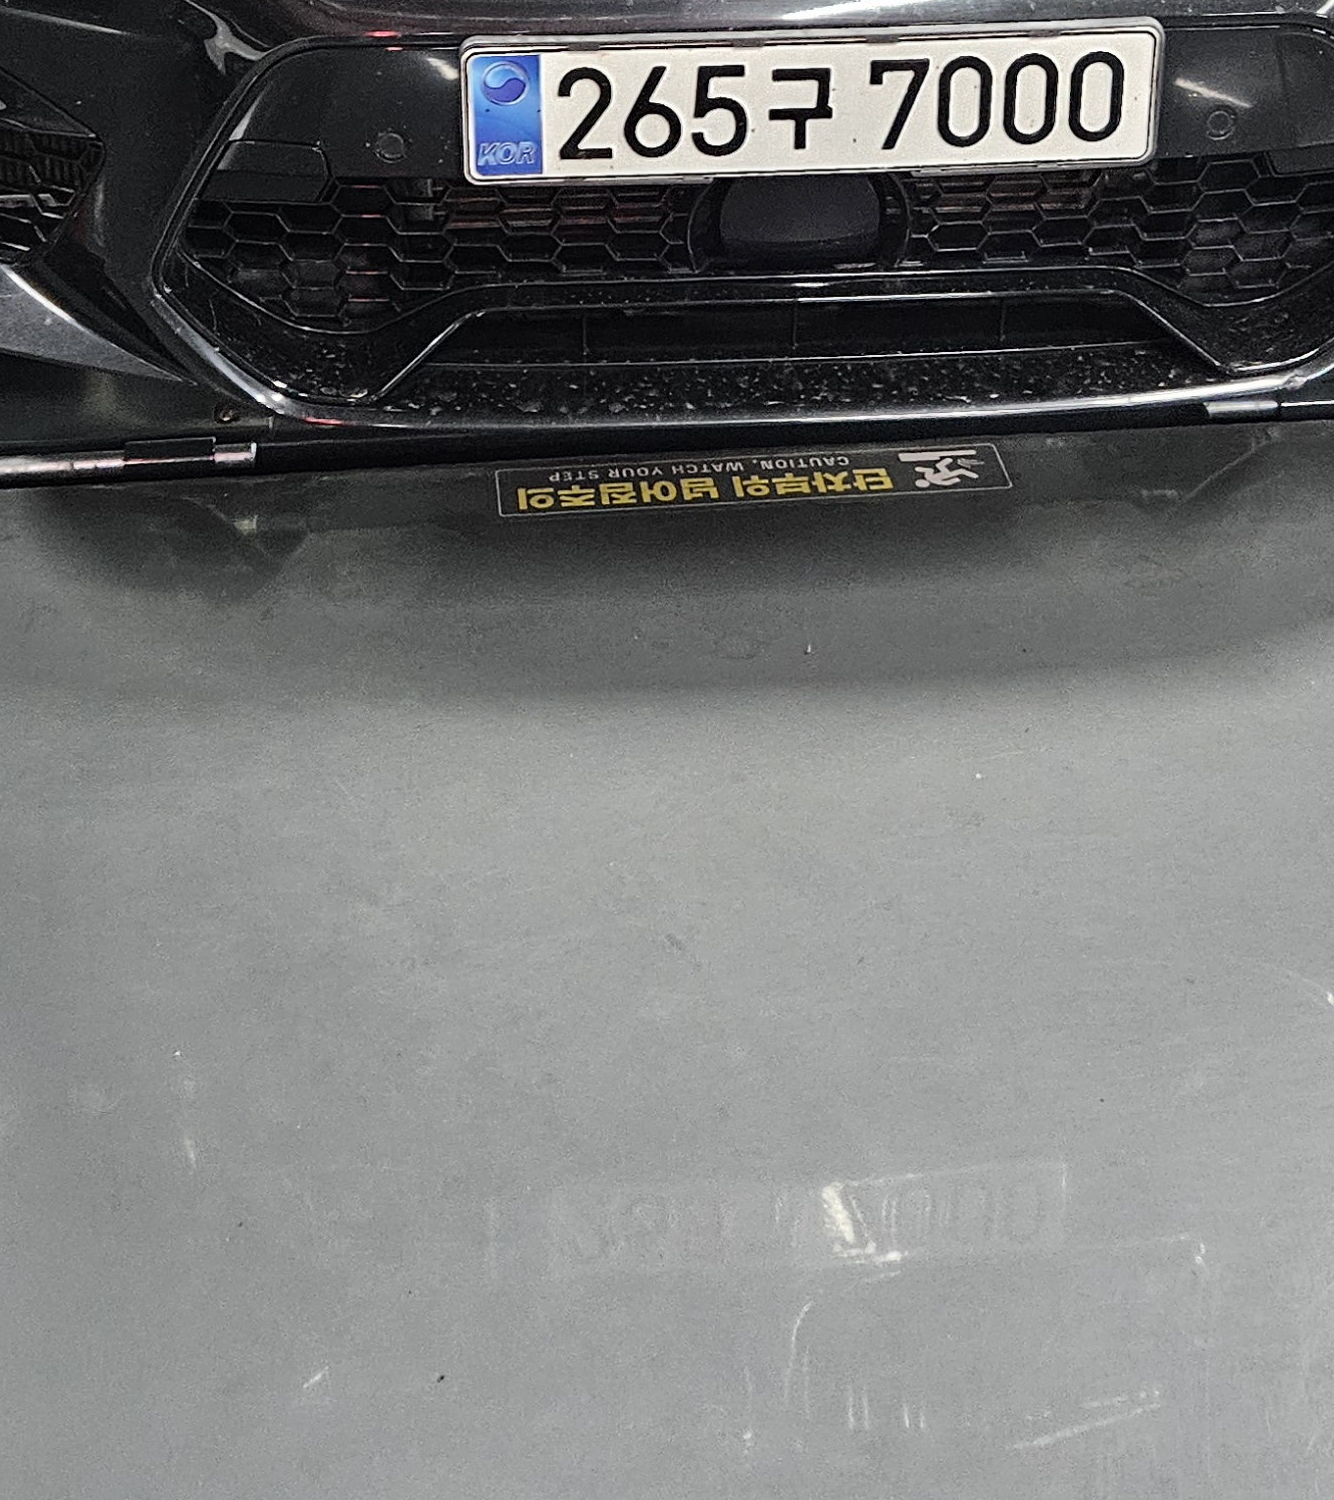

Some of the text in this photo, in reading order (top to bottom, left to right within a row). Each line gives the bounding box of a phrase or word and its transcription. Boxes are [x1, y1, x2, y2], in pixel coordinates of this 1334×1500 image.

[556, 51, 1125, 161] 265구 7000
[477, 141, 536, 166] KOR
[549, 470, 600, 482] STEP
[608, 466, 663, 479] YOUR
[672, 461, 745, 475] WATCH
[517, 467, 894, 510] 단차부위 넘어짐주의
